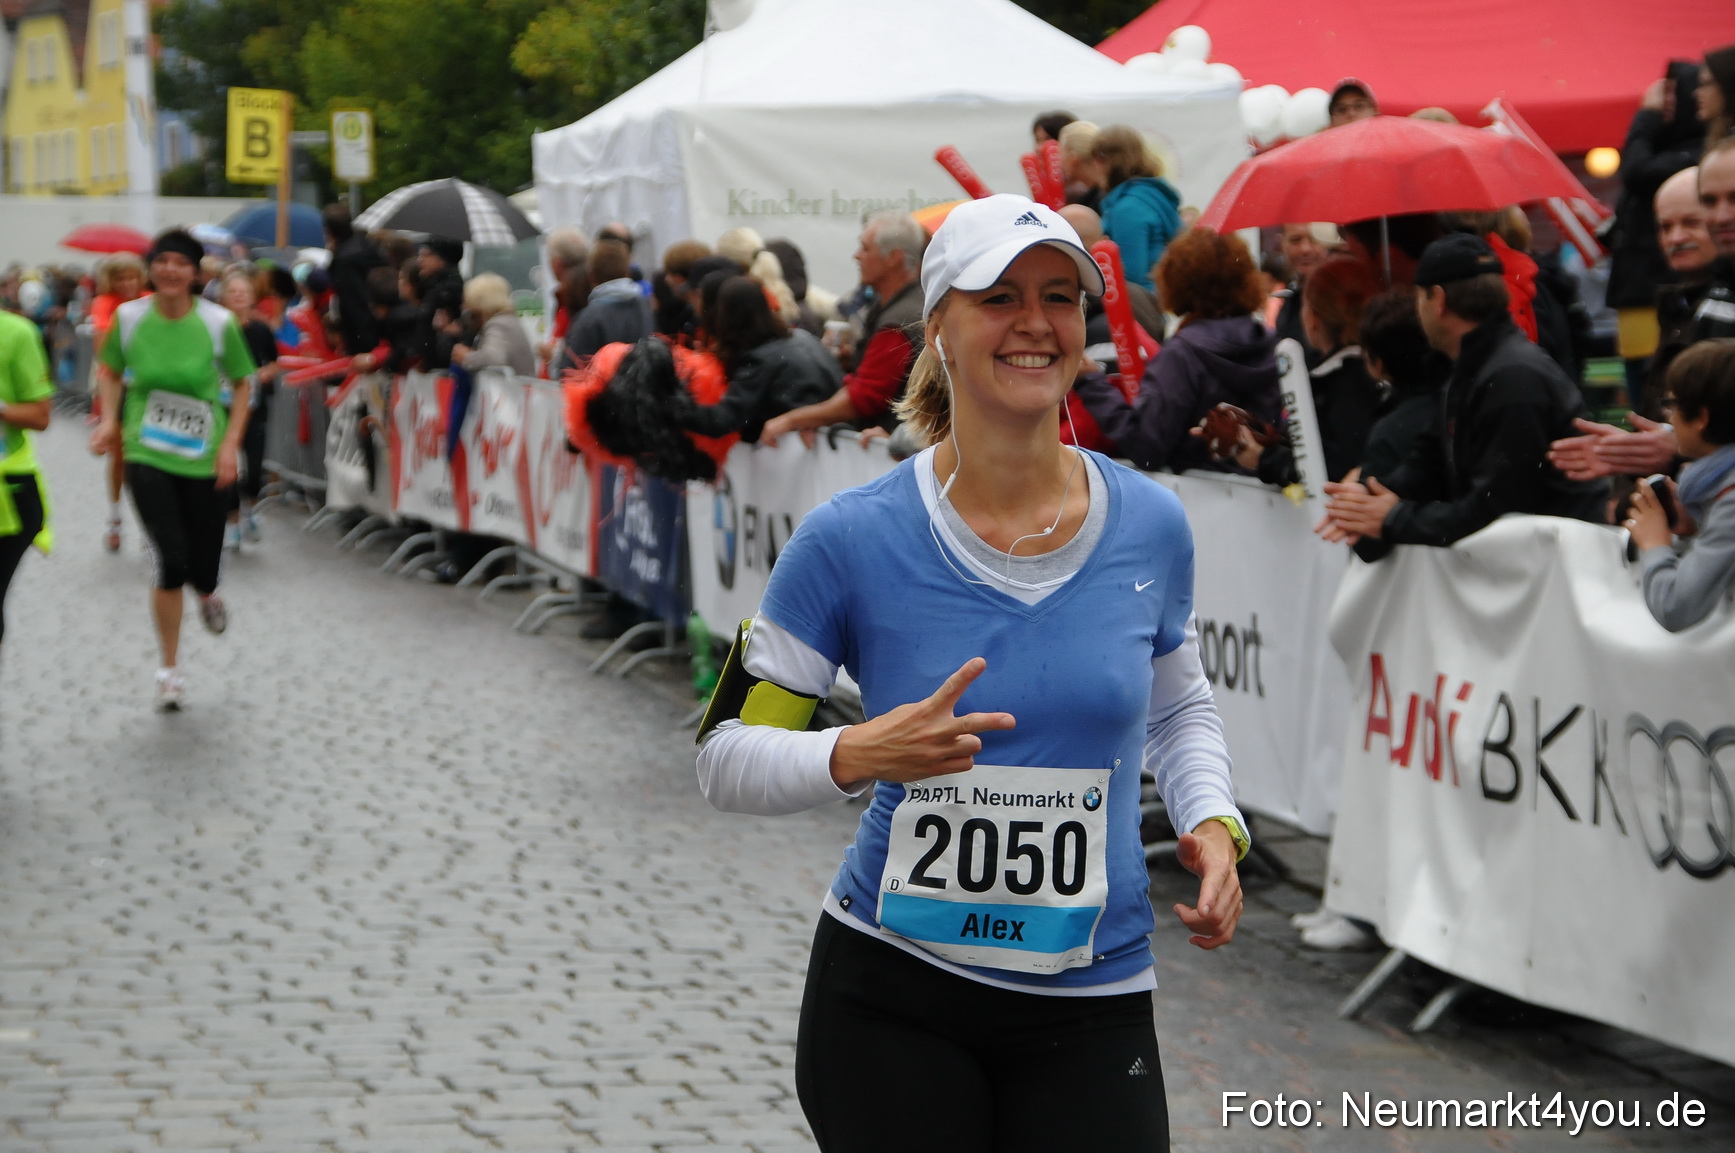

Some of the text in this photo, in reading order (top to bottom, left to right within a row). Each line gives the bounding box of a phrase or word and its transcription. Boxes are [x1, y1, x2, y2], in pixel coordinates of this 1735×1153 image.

[245, 117, 271, 158] B
[727, 188, 823, 215] Kinder
[1014, 220, 1048, 229] adidas
[150, 403, 205, 437] 3183
[1197, 611, 1265, 698] port
[1363, 653, 1629, 836] Audi BKK
[907, 786, 966, 805] PARTL
[973, 787, 1075, 808] Neumarkt
[907, 813, 1087, 896] 2050
[890, 879, 900, 891] D
[960, 913, 1026, 942] Alex
